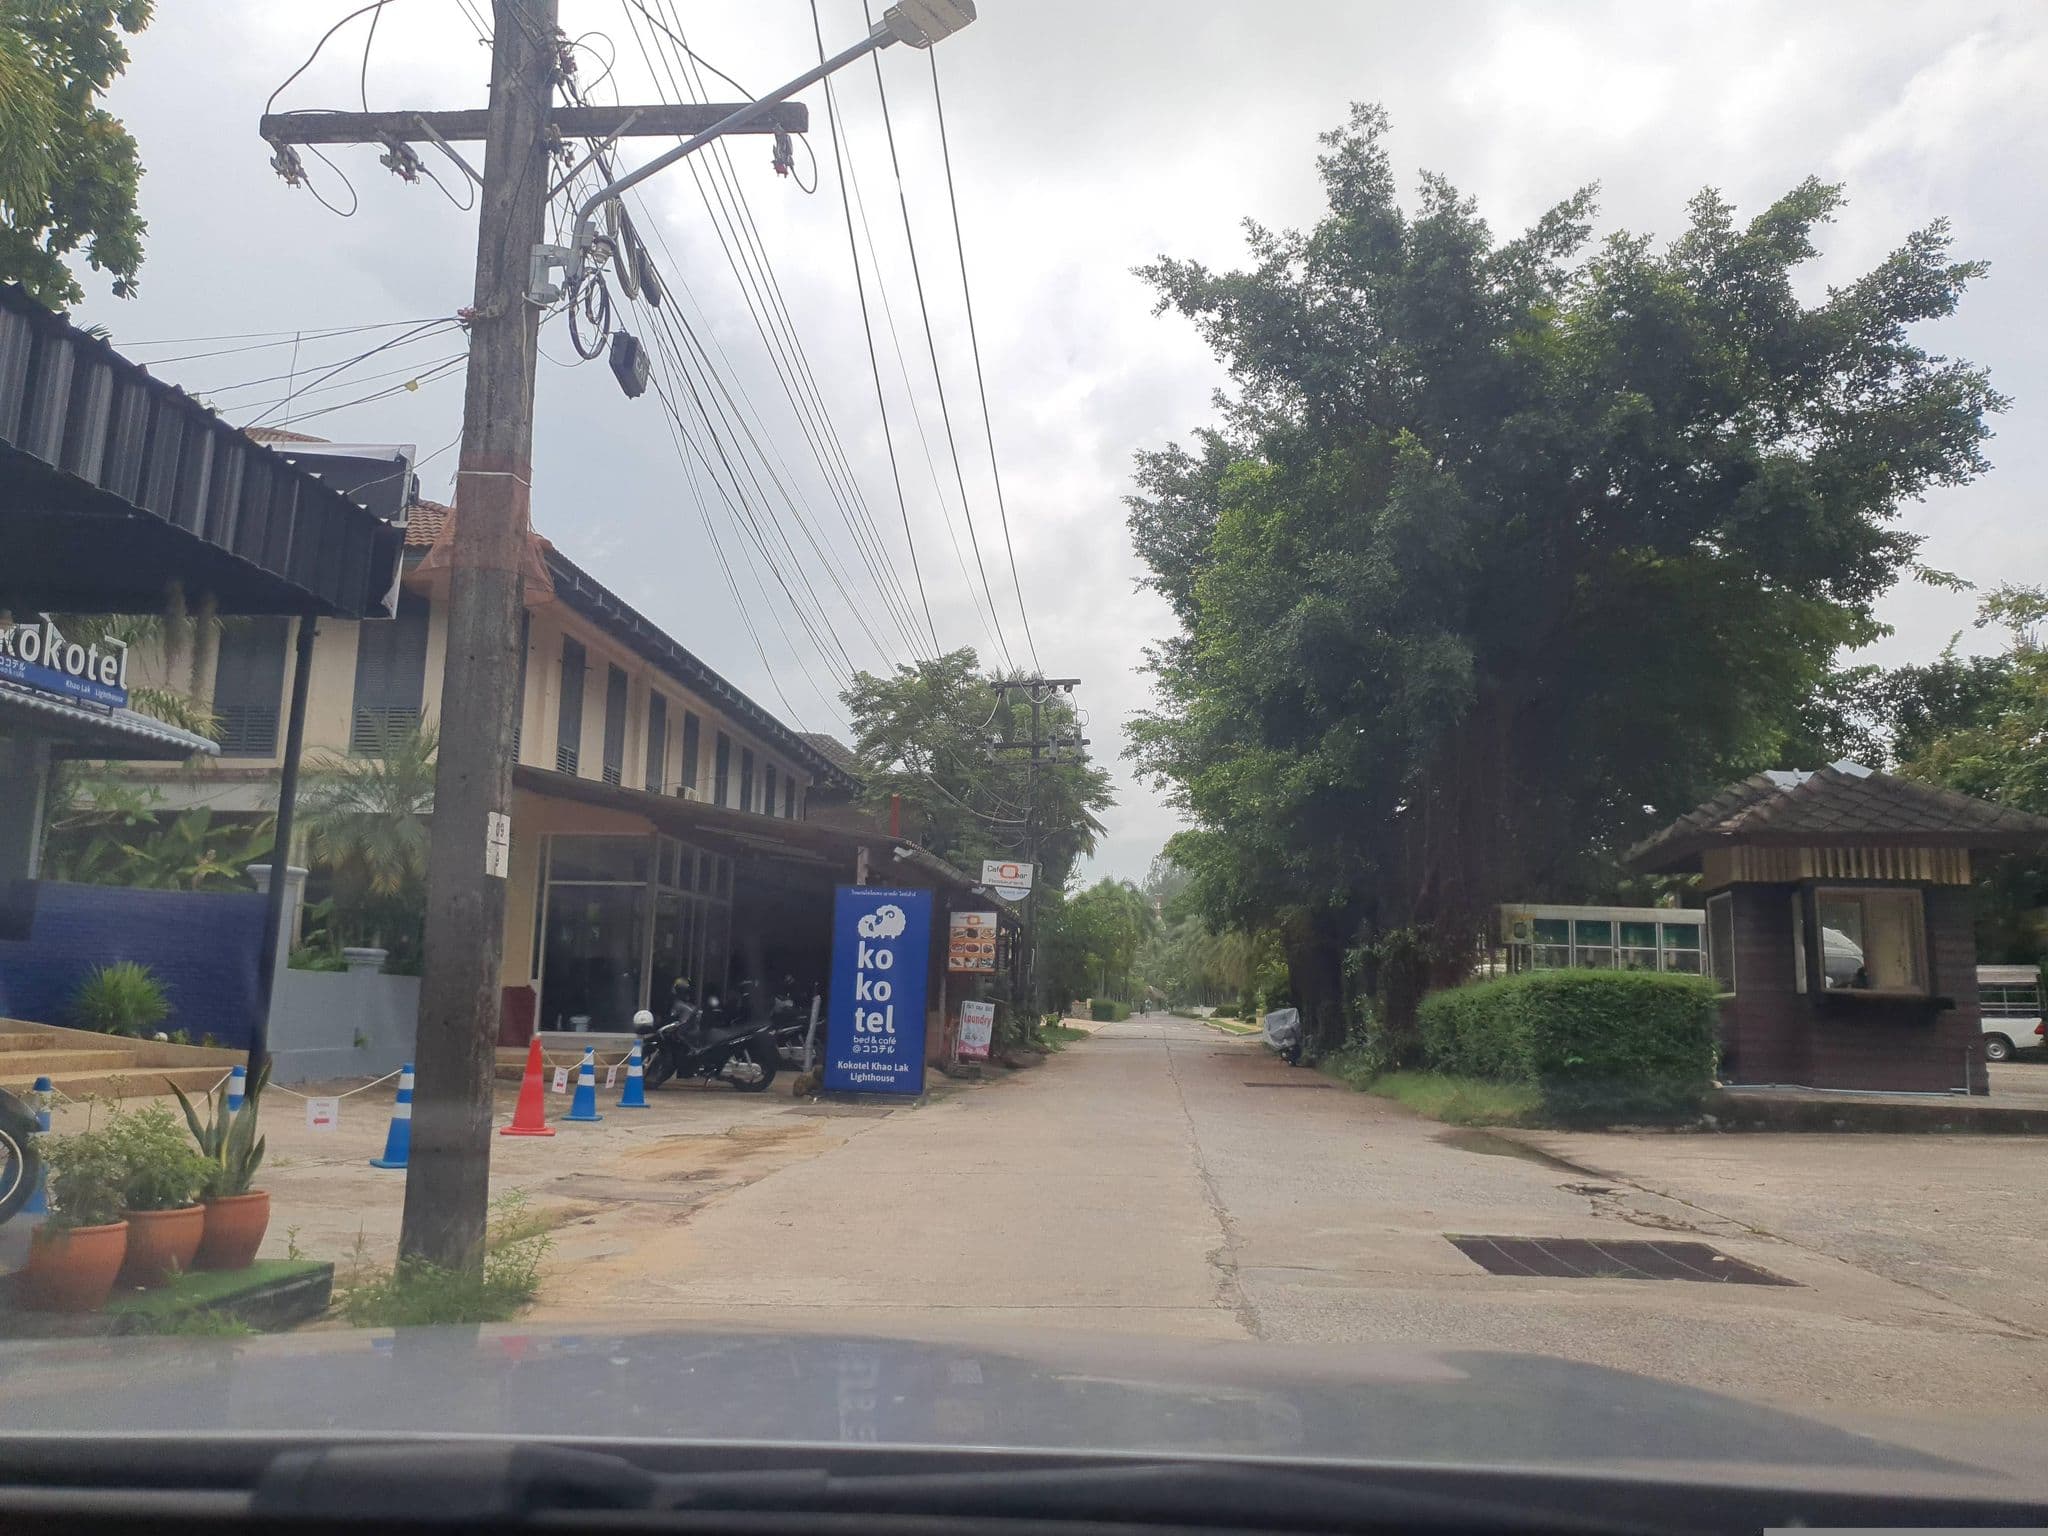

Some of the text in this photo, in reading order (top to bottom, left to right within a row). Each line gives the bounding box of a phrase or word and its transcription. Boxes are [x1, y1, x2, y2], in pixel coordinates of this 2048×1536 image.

[66, 680, 80, 691] Khao
[81, 683, 91, 693] Lak
[858, 940, 894, 970] ko
[856, 972, 892, 1002] ko
[855, 1004, 896, 1034] tel
[853, 1034, 897, 1045] bed & café
[837, 1060, 909, 1072] Kokotel Khao Lak
[850, 1072, 895, 1083] Lighthouse
